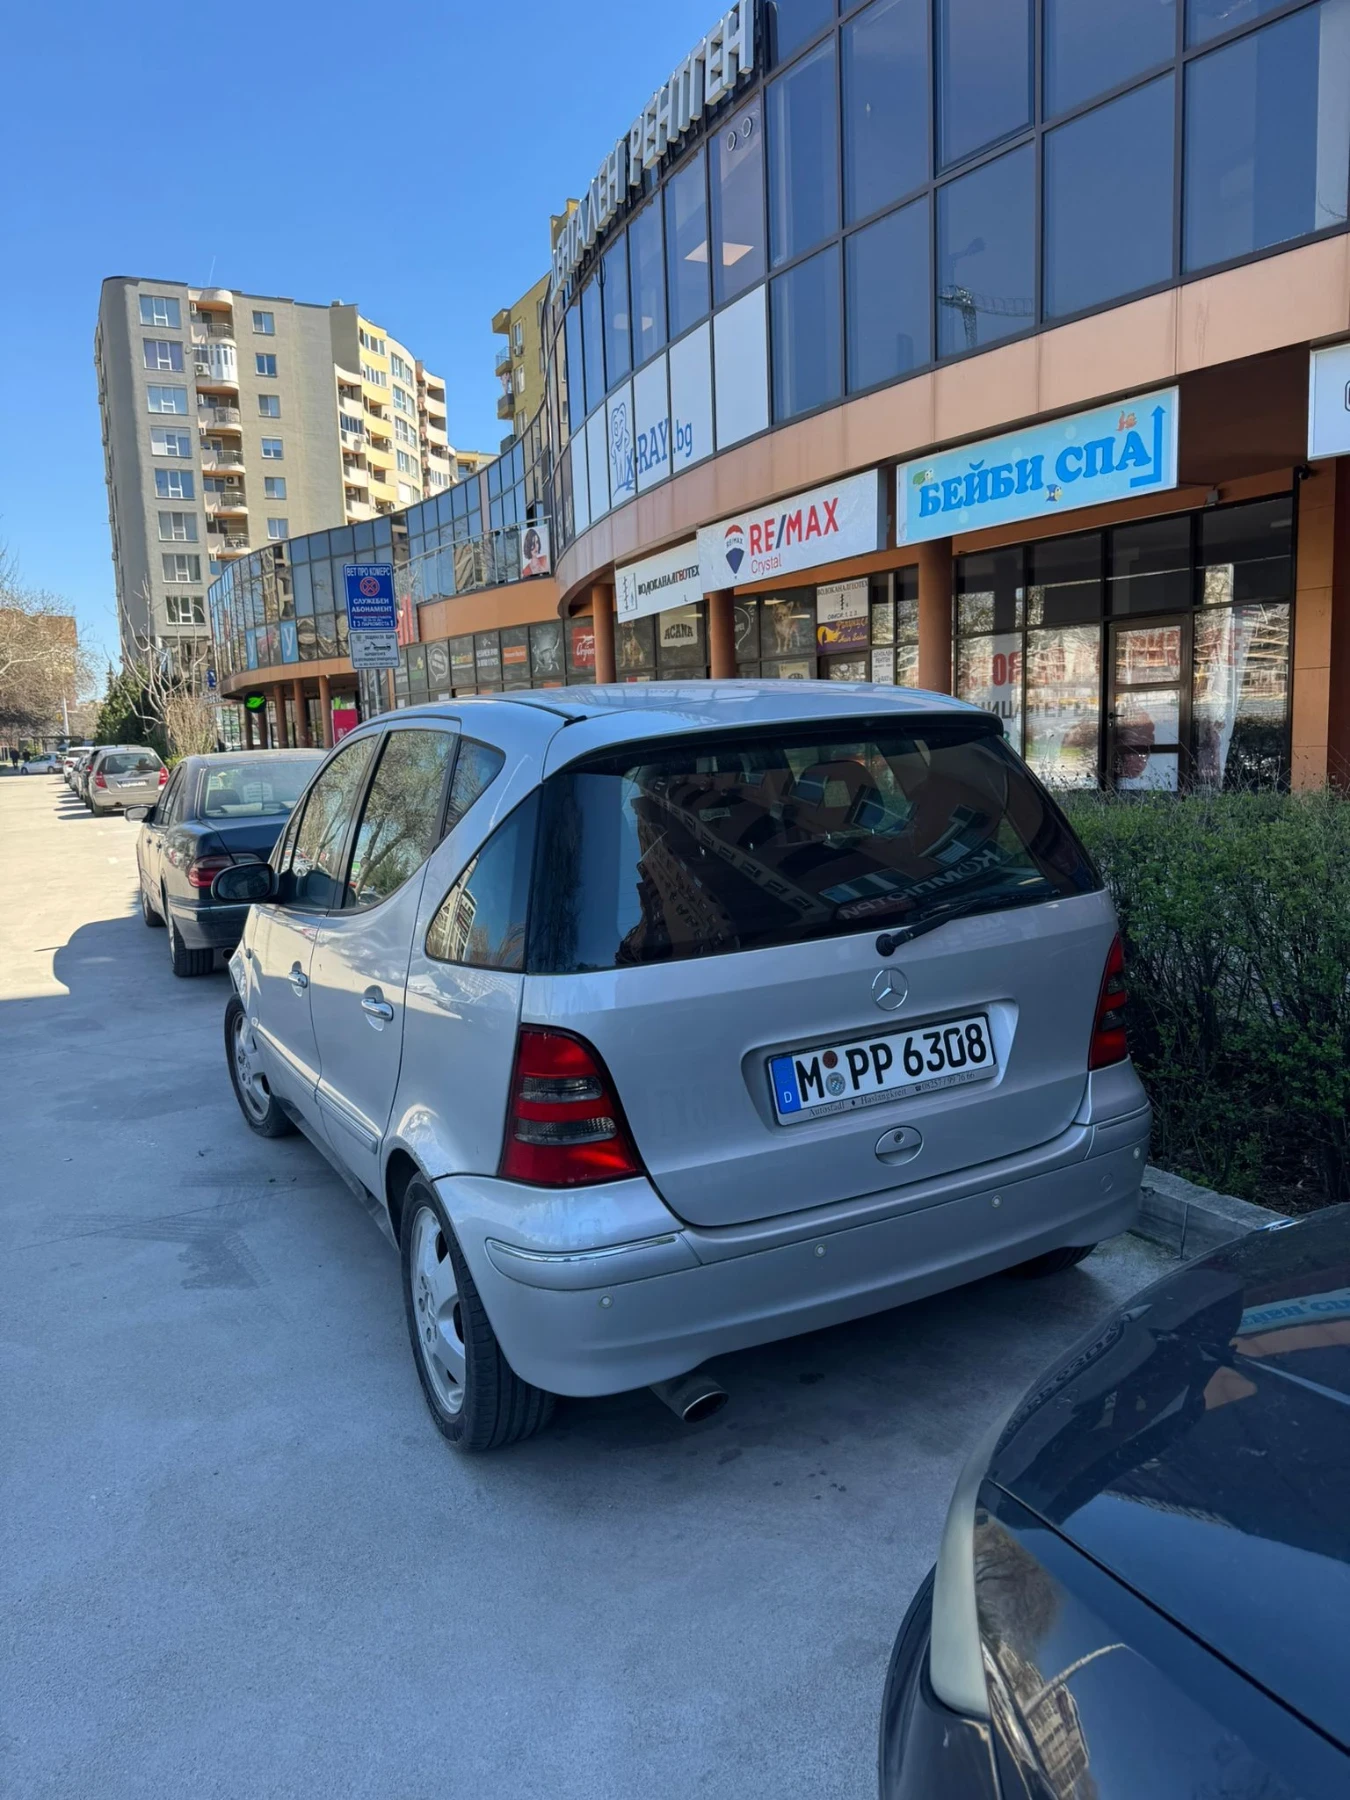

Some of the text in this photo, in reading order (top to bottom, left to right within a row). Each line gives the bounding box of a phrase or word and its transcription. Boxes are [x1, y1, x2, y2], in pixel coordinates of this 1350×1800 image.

[630, 0, 754, 187] РЕНТГЕН
[919, 430, 1152, 518] БЕЙБИ СПА
[749, 497, 839, 557] RE/MAX
[751, 553, 783, 575] Crystal
[351, 605, 392, 613] АБОНАМЕНТ
[352, 597, 389, 605] СЛУЖЕБЕН
[664, 623, 693, 640] ACANA
[795, 1023, 987, 1102] M PP 6308
[783, 1090, 793, 1103] D
